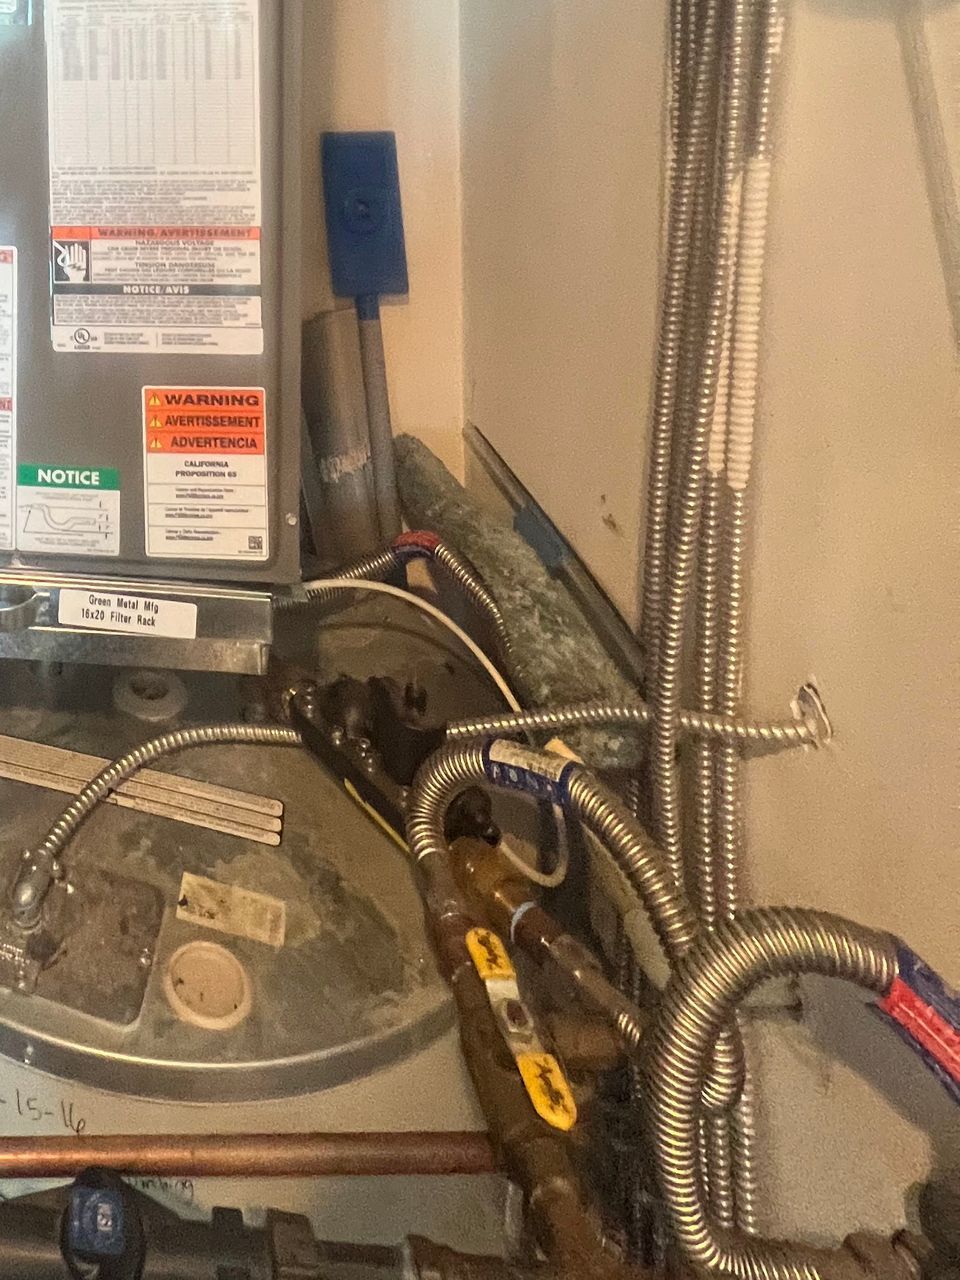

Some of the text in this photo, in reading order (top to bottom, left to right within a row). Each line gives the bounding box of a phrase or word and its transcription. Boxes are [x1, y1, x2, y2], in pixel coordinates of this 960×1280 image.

[164, 394, 260, 407] WARNING
[165, 415, 260, 428] AVERTISSEMENT
[171, 436, 258, 449] ADVERTENCIA
[184, 460, 229, 468] CALIFORNIA
[37, 468, 101, 485] NOTICE
[175, 470, 226, 478] PROPOSITION
[88, 594, 159, 614] Green Metal Mfg
[81, 608, 156, 627] 16x20 Filter Rack
